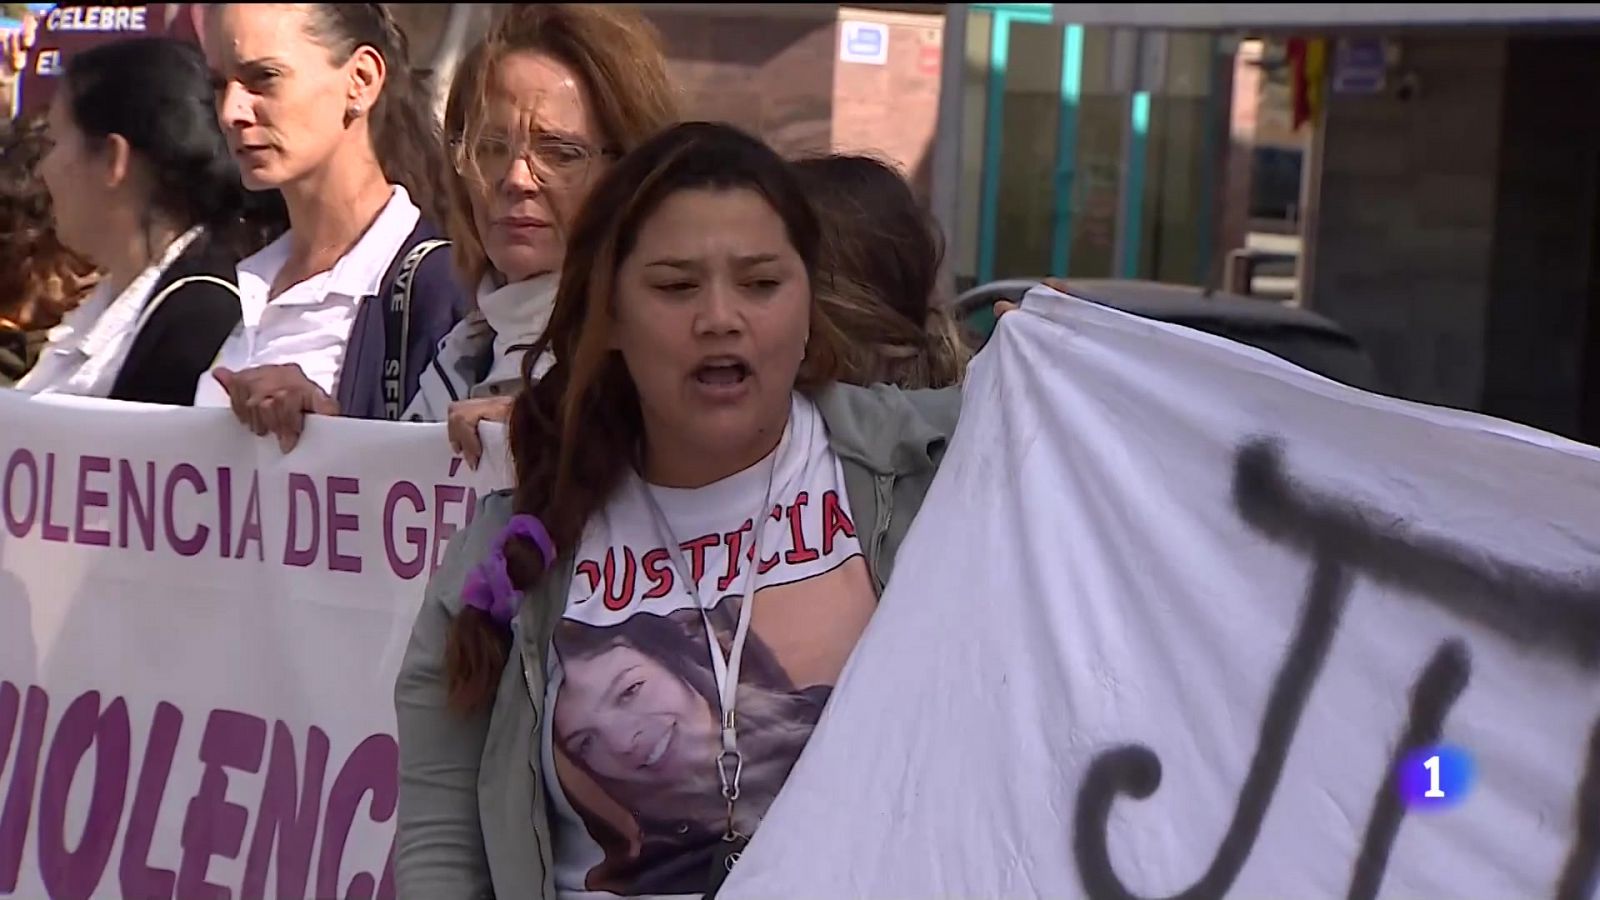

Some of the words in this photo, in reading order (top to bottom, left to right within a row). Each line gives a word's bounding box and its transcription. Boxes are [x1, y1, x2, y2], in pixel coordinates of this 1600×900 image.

[47, 6, 147, 31] CELEBRE
[283, 472, 362, 573] DE
[383, 457, 477, 584] GÉ
[0, 680, 398, 900] IOLENC
